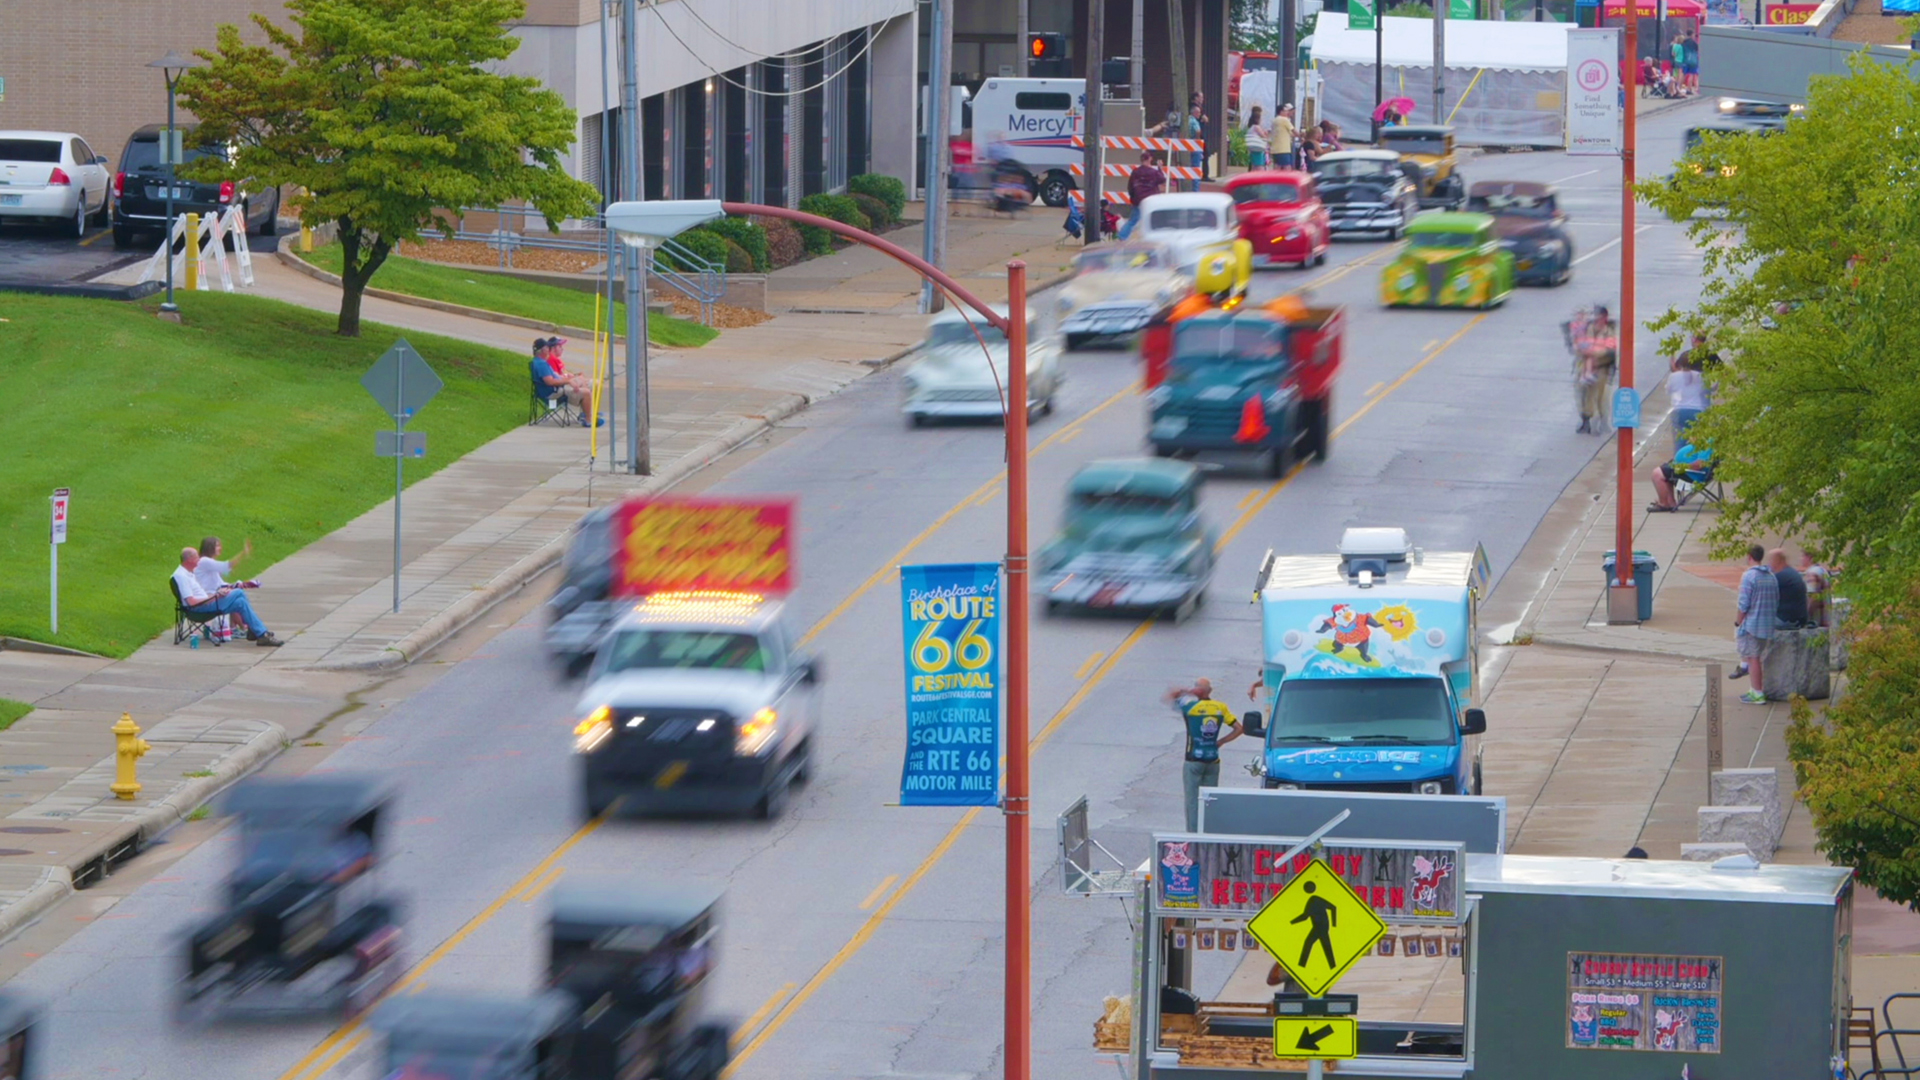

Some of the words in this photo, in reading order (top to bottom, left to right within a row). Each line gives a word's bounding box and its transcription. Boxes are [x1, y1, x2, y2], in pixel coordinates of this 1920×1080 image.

[1574, 103, 1611, 111] Something
[1580, 110, 1605, 118] Unique
[1009, 114, 1066, 136] Mercy
[907, 583, 977, 603] Birthplace
[982, 578, 997, 597] of
[911, 596, 995, 621] ROUTE
[911, 619, 992, 673] 66
[911, 672, 995, 692] FESTIVAL
[1709, 677, 1718, 699] ZONE
[912, 708, 940, 727] PARK
[940, 708, 992, 723] CENTRAL
[1709, 702, 1718, 737] LOADING
[911, 727, 992, 746] SQUARE
[910, 750, 924, 760] AND
[927, 750, 960, 771] RTE
[966, 750, 992, 771] 66
[909, 760, 924, 771] THE
[905, 775, 956, 790] MOTOR
[960, 775, 992, 790] MILE
[1254, 849, 1363, 876] COWOY
[1606, 978, 1615, 986] $3
[1655, 980, 1664, 988] $5
[1671, 982, 1691, 990] Large
[1693, 981, 1706, 989] $10
[1600, 1009, 1627, 1018] Regular
